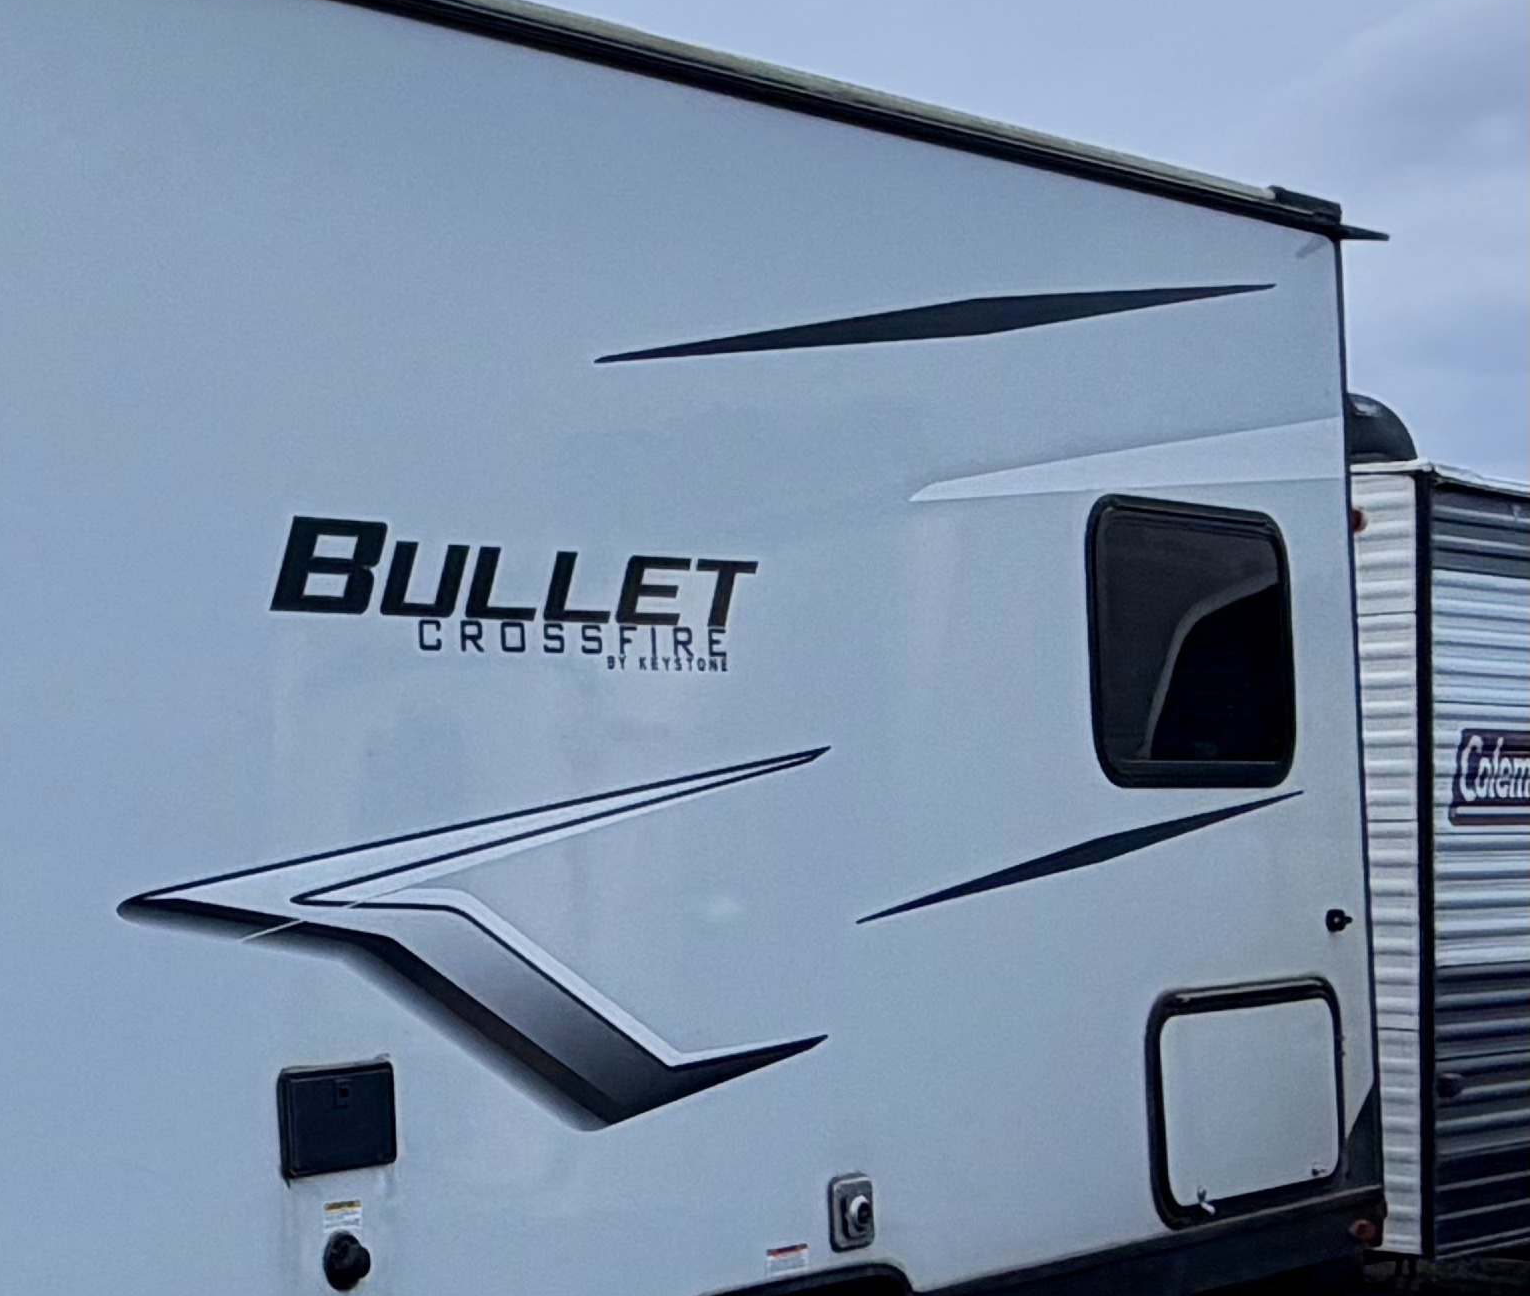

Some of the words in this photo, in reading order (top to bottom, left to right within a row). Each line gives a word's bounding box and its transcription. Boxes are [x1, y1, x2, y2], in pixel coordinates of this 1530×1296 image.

[269, 516, 759, 628] BULLET
[418, 619, 728, 658] CROSSFIRE
[607, 655, 627, 671] BY
[639, 655, 729, 673] KEYSTONE
